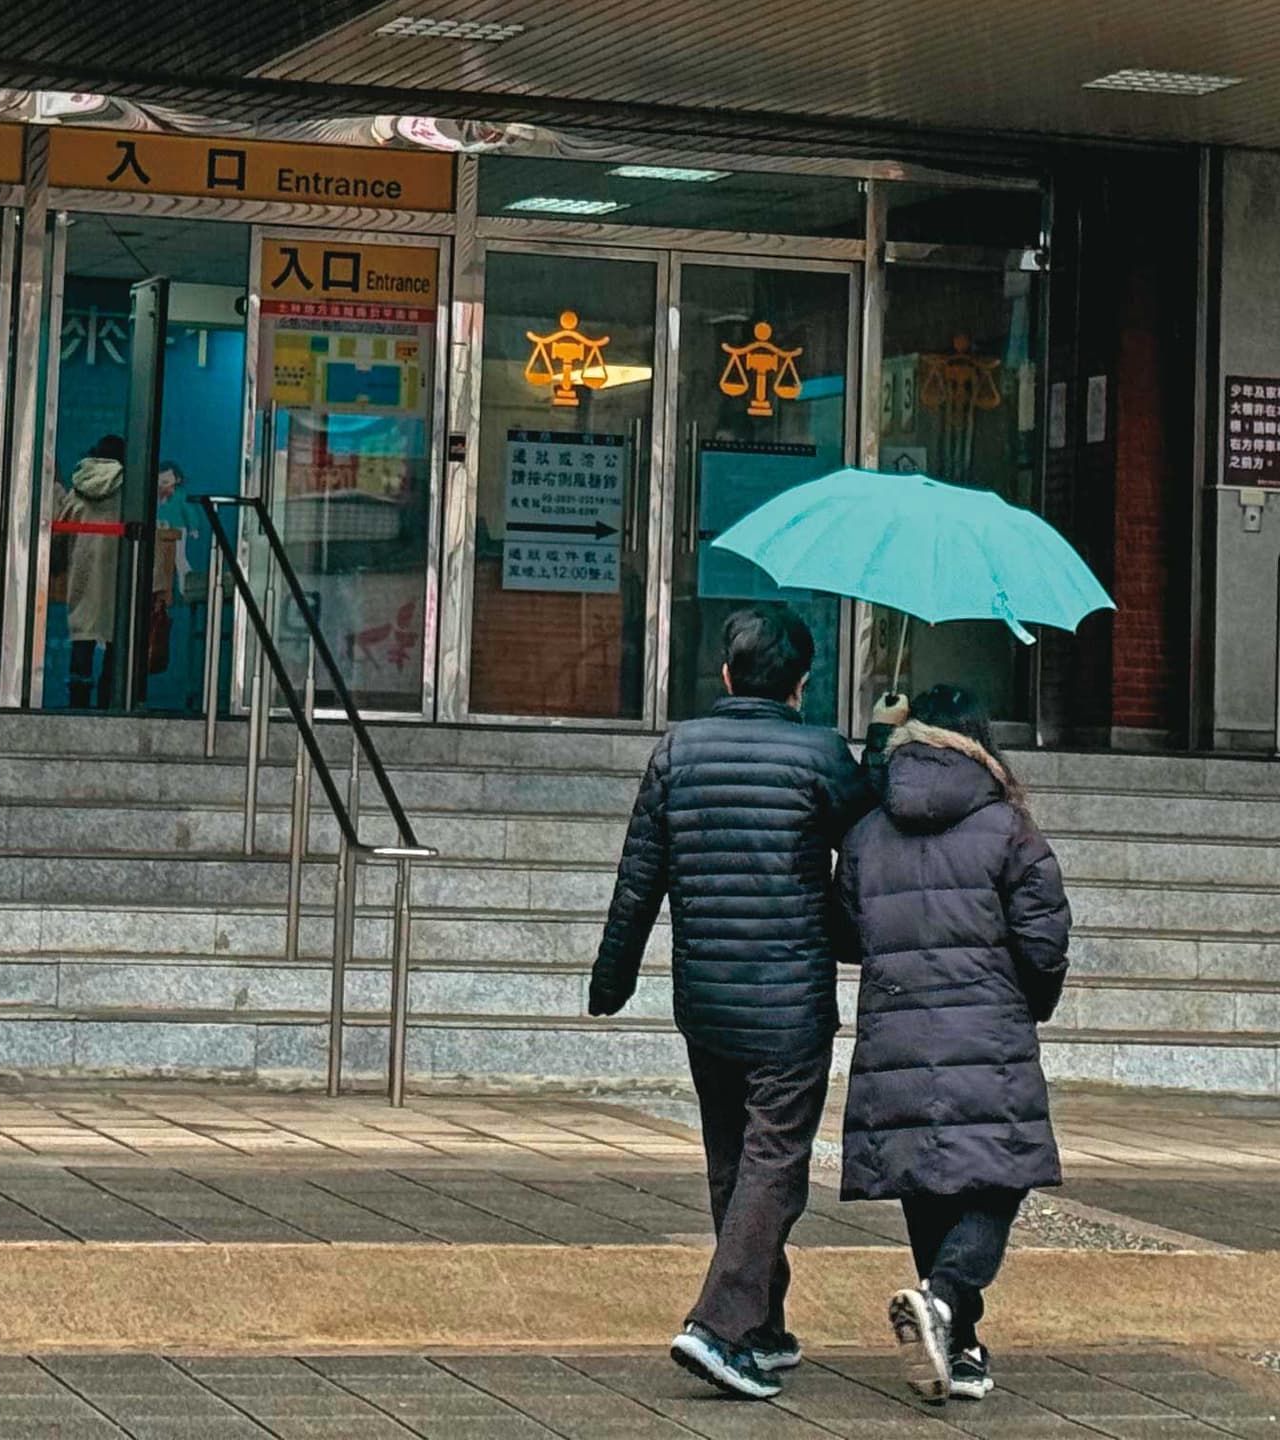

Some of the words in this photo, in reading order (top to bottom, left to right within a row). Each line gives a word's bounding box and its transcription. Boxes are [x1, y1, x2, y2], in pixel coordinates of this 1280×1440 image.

[107, 141, 246, 191] 入口
[278, 168, 402, 199] Entrance
[271, 247, 361, 293] 入口
[367, 269, 431, 294] Entrance
